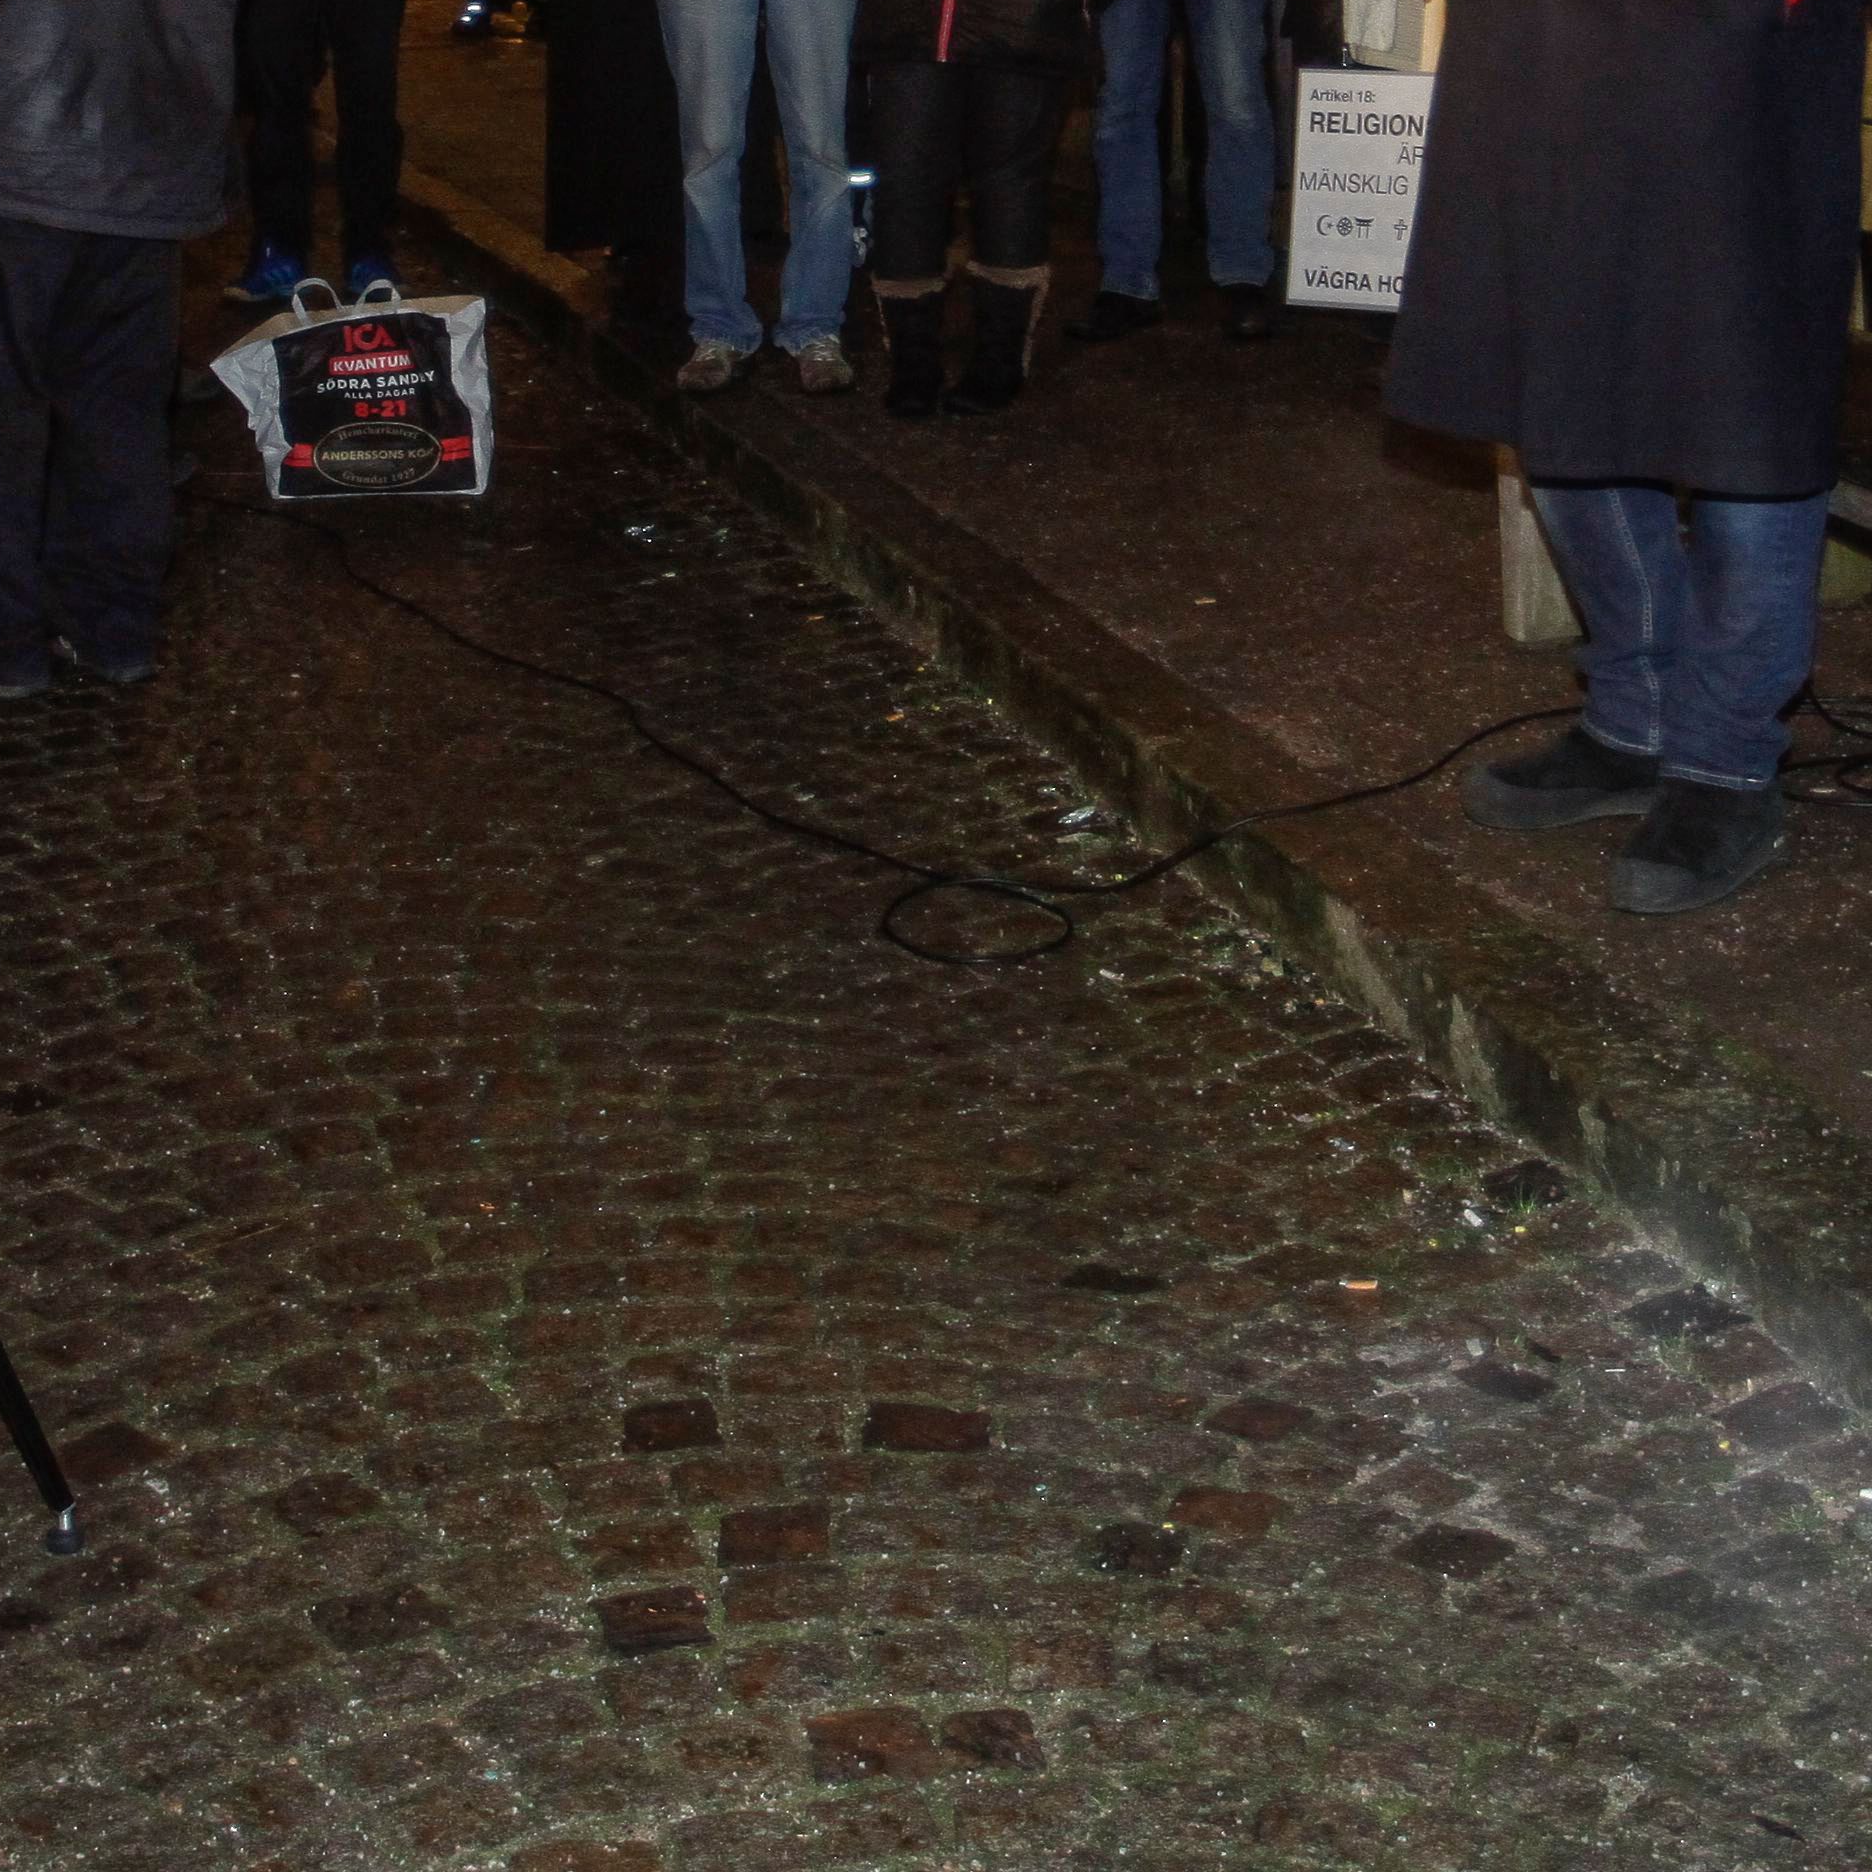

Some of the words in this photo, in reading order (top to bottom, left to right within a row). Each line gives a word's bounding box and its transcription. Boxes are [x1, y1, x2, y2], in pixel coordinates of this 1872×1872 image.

[1310, 89, 1353, 102] Artikel
[1358, 91, 1376, 103] 18:
[1309, 111, 1425, 137] RELIGION
[1299, 168, 1408, 196] MÄNSKLIG
[1305, 266, 1372, 293] VÄGRA
[343, 324, 396, 353] ICA
[334, 355, 410, 371] KVANTUM
[317, 378, 371, 394] SÖDRA
[344, 391, 372, 399] ALLA
[377, 387, 416, 399] DAGAR
[355, 401, 407, 418] 8-21
[321, 451, 405, 461] ANDERSSONS
